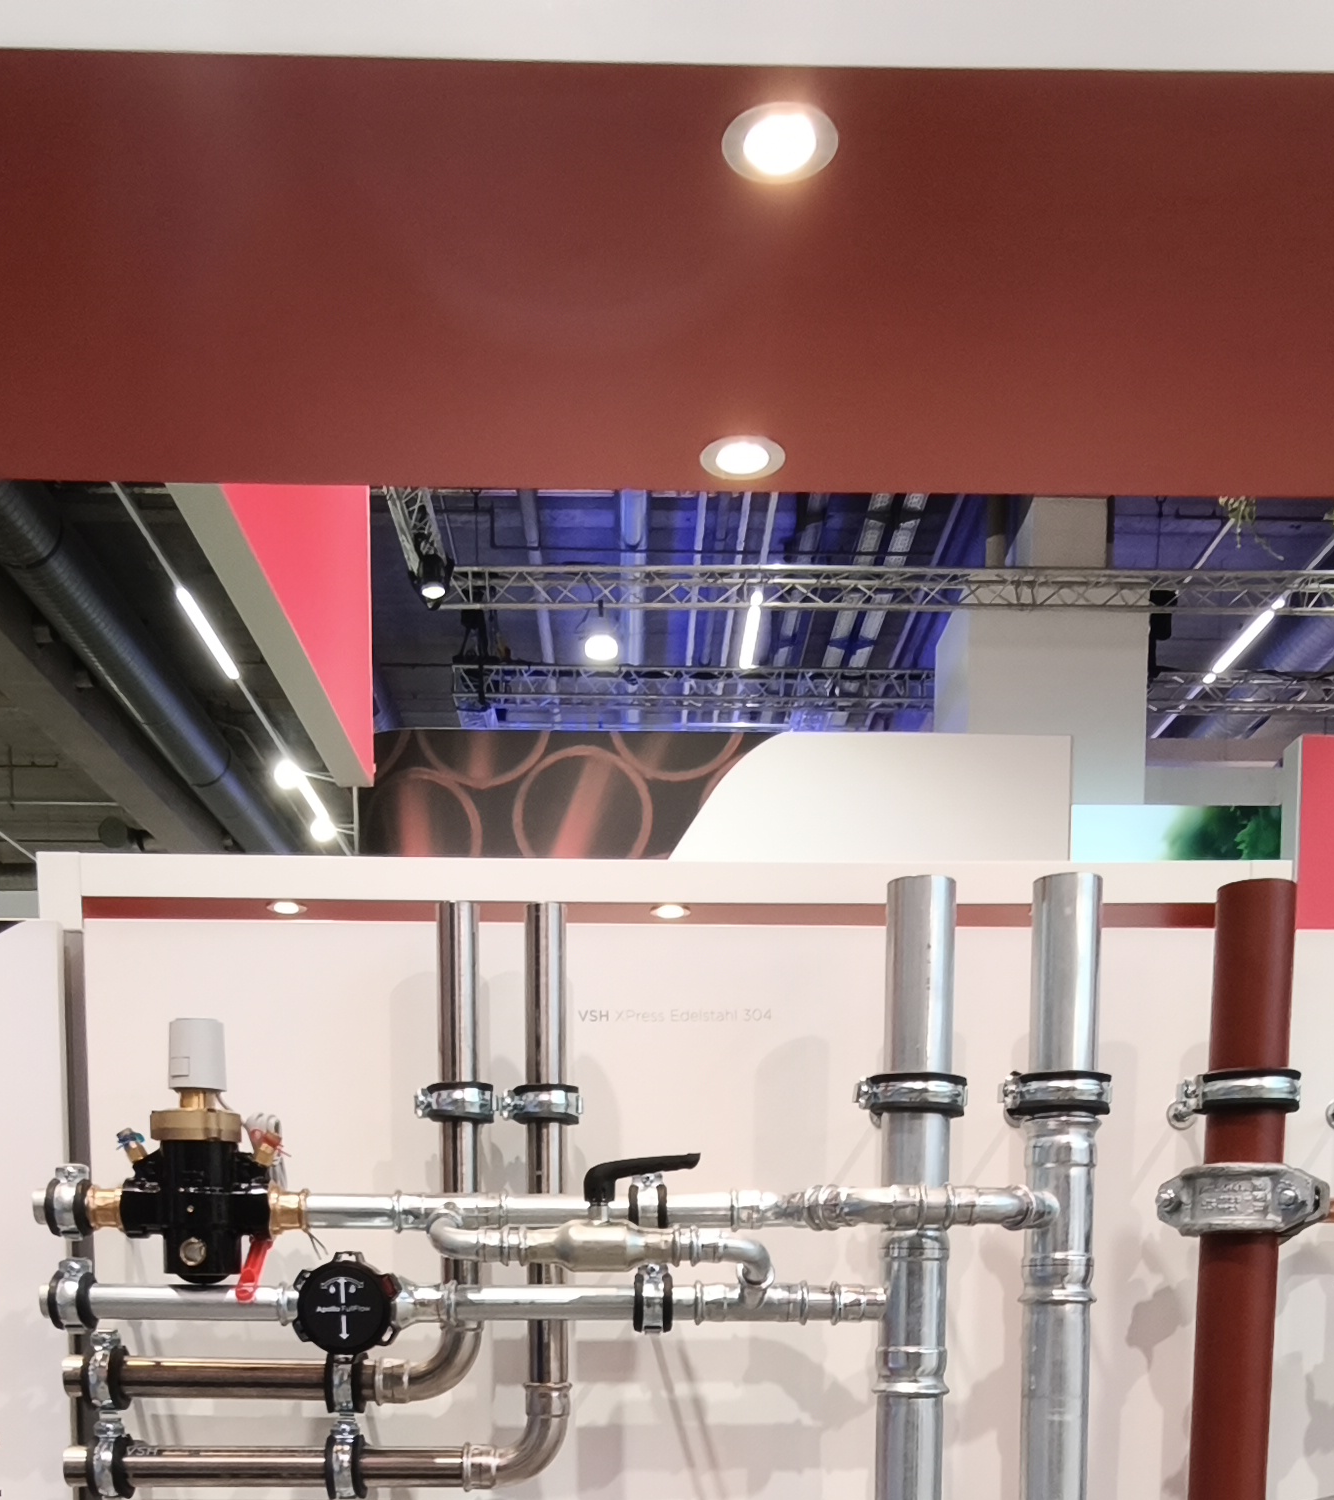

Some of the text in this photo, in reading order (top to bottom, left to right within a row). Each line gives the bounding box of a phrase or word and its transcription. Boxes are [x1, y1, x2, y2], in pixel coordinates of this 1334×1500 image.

[577, 1008, 772, 1022] VSH XPress Edelstahl 304
